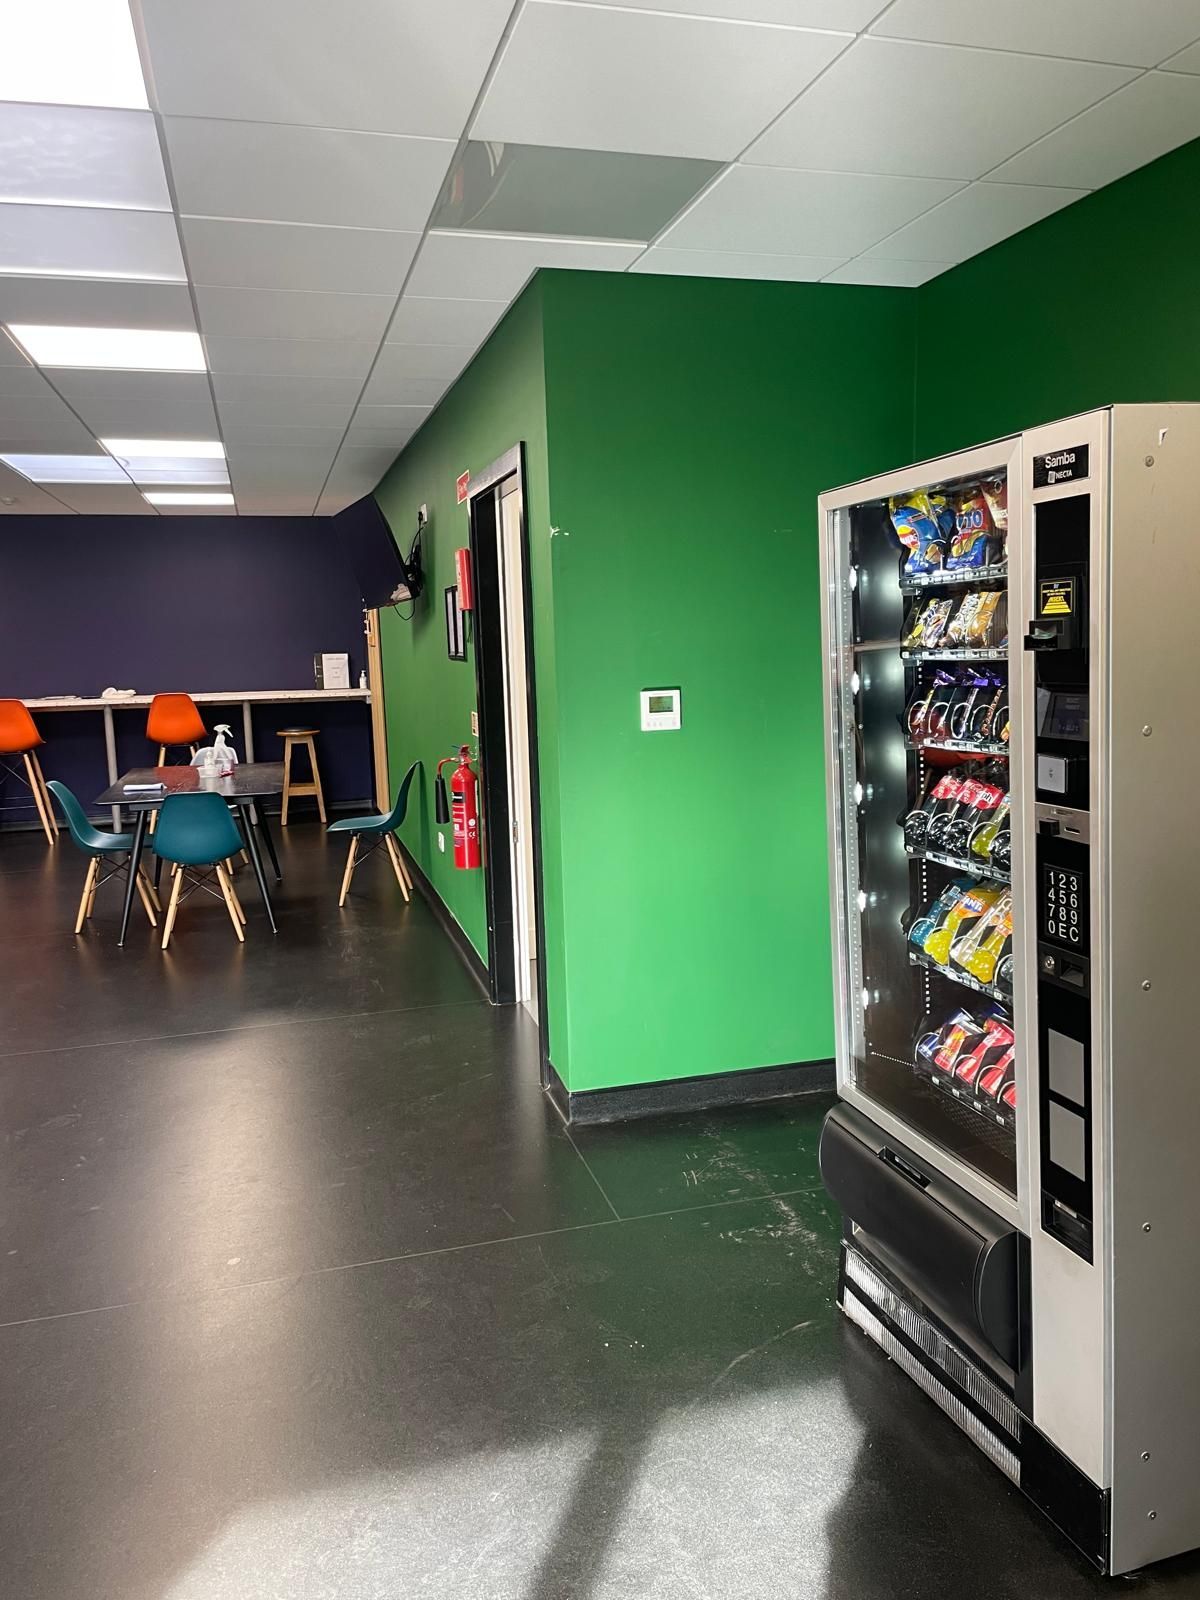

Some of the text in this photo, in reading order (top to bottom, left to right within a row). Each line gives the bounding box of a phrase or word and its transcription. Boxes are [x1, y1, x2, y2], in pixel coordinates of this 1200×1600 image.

[1045, 452, 1076, 469] Samba
[1055, 469, 1073, 480] NECTA
[1049, 871, 1078, 891] 1 2 3
[1048, 887, 1078, 908] 4 5 6
[1047, 902, 1078, 925] 7 8 9
[1048, 920, 1079, 942] 0 E C
